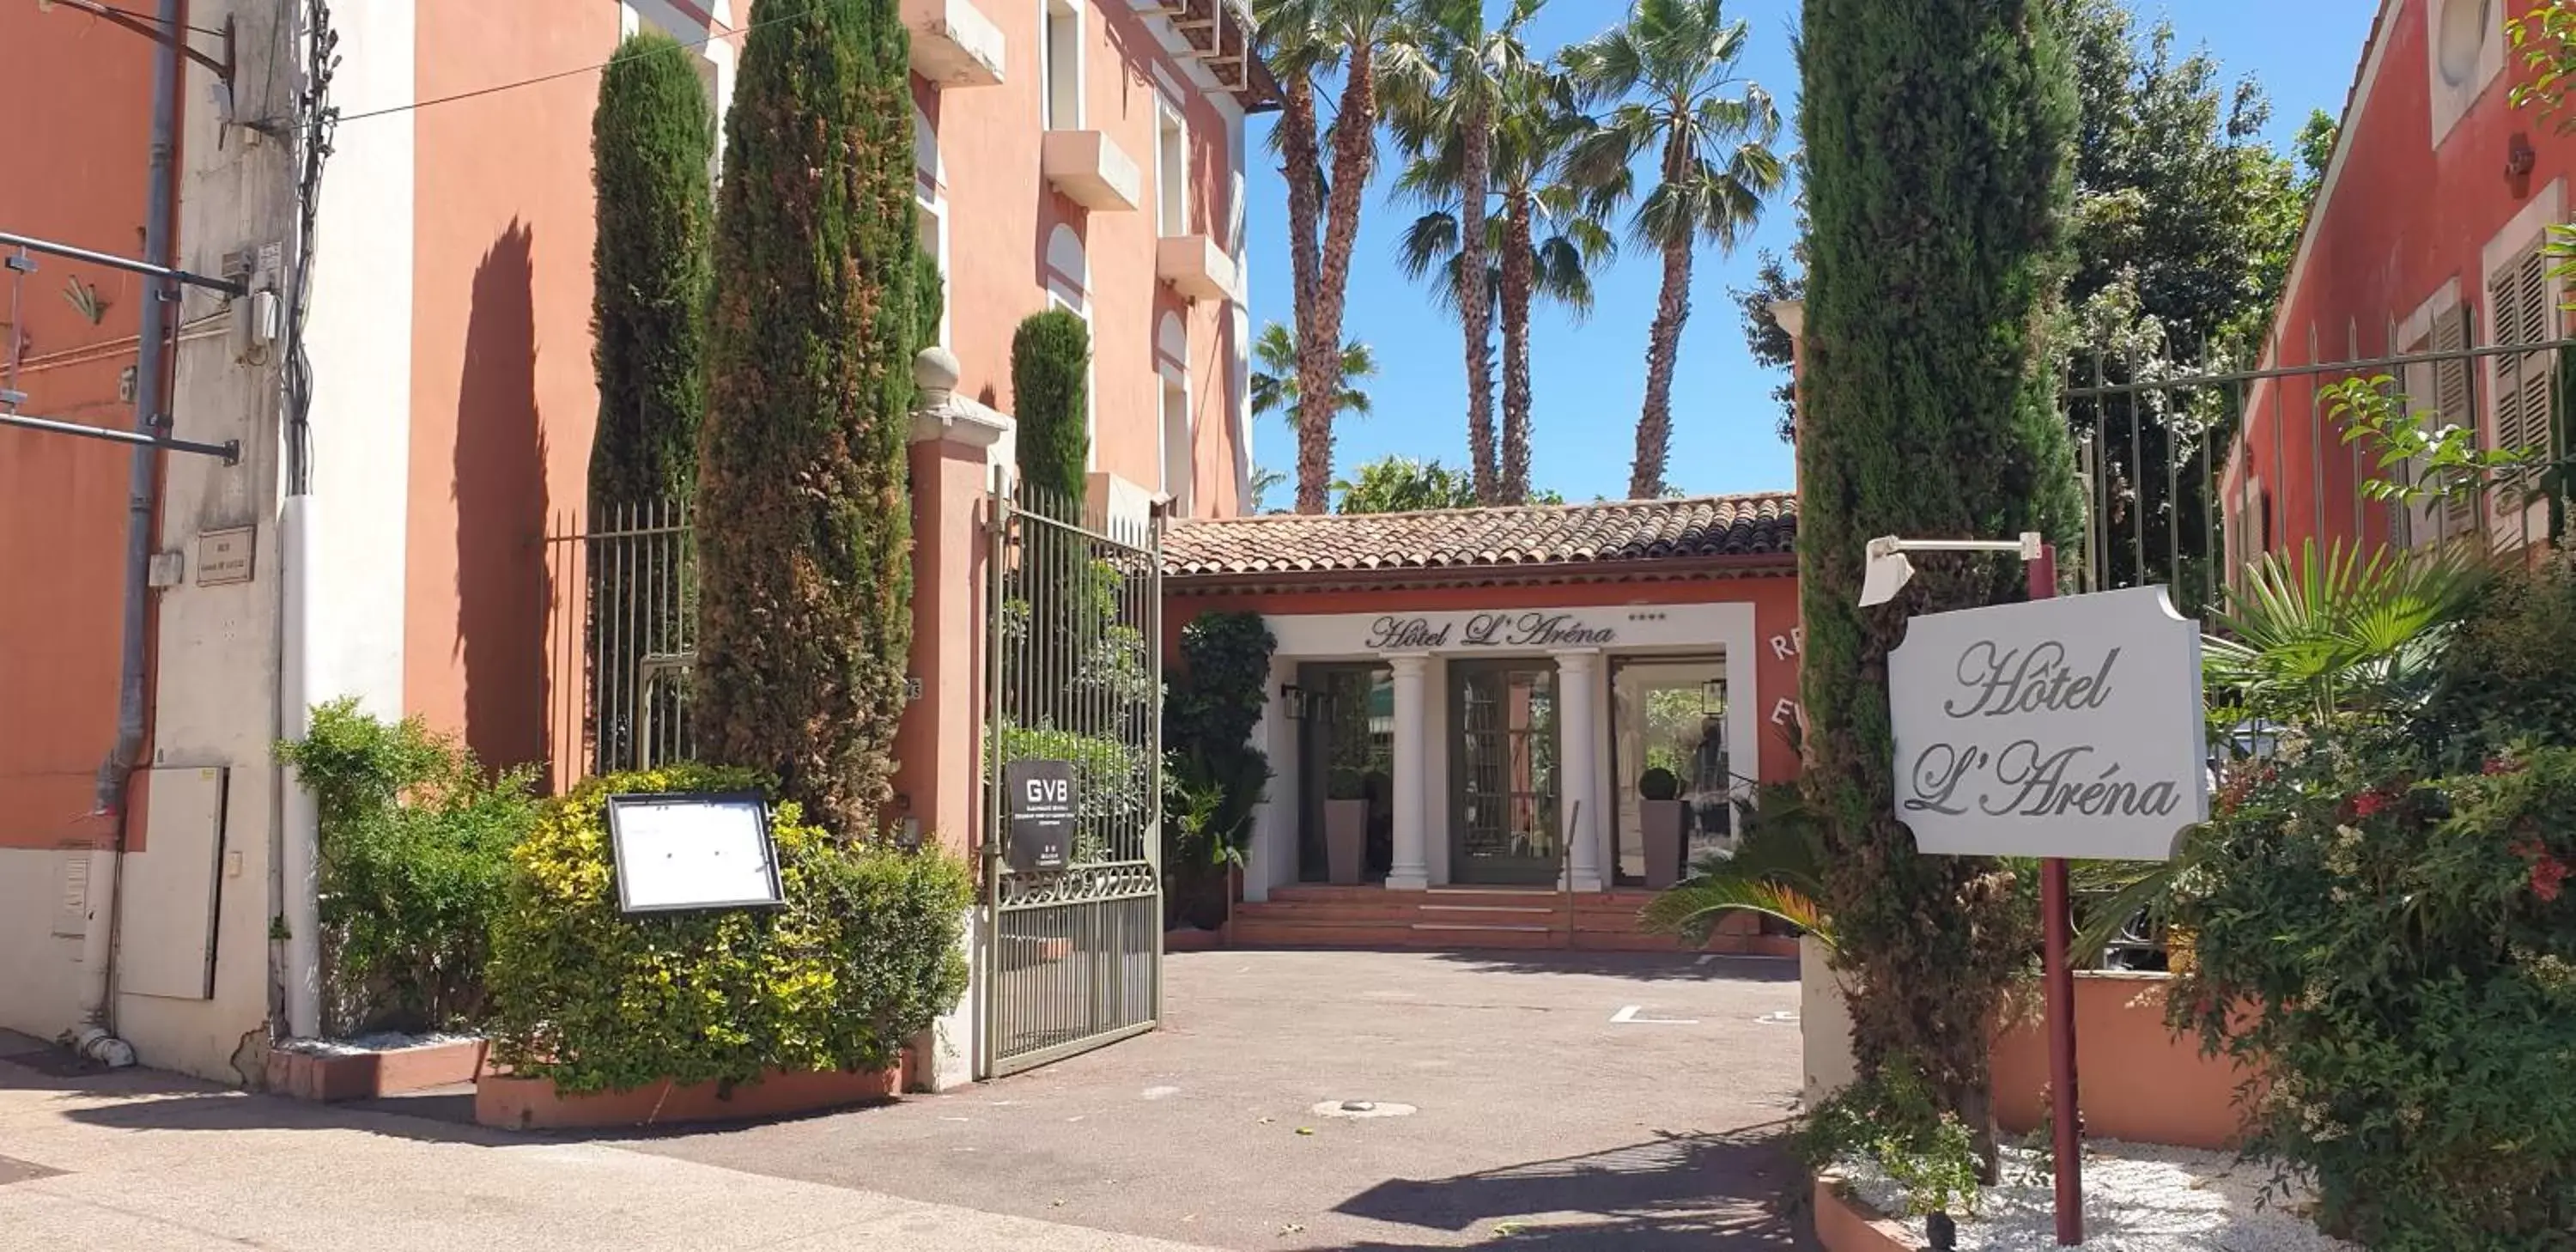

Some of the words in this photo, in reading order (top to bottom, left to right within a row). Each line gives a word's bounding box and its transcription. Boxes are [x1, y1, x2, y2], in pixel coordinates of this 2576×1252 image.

[1365, 616, 1451, 648] Hôtel
[1461, 612, 1617, 646] L'Aréna
[1943, 640, 2122, 719] Hôtel
[1026, 779, 1067, 802] GVB
[1904, 739, 2181, 817] L'Aréna
